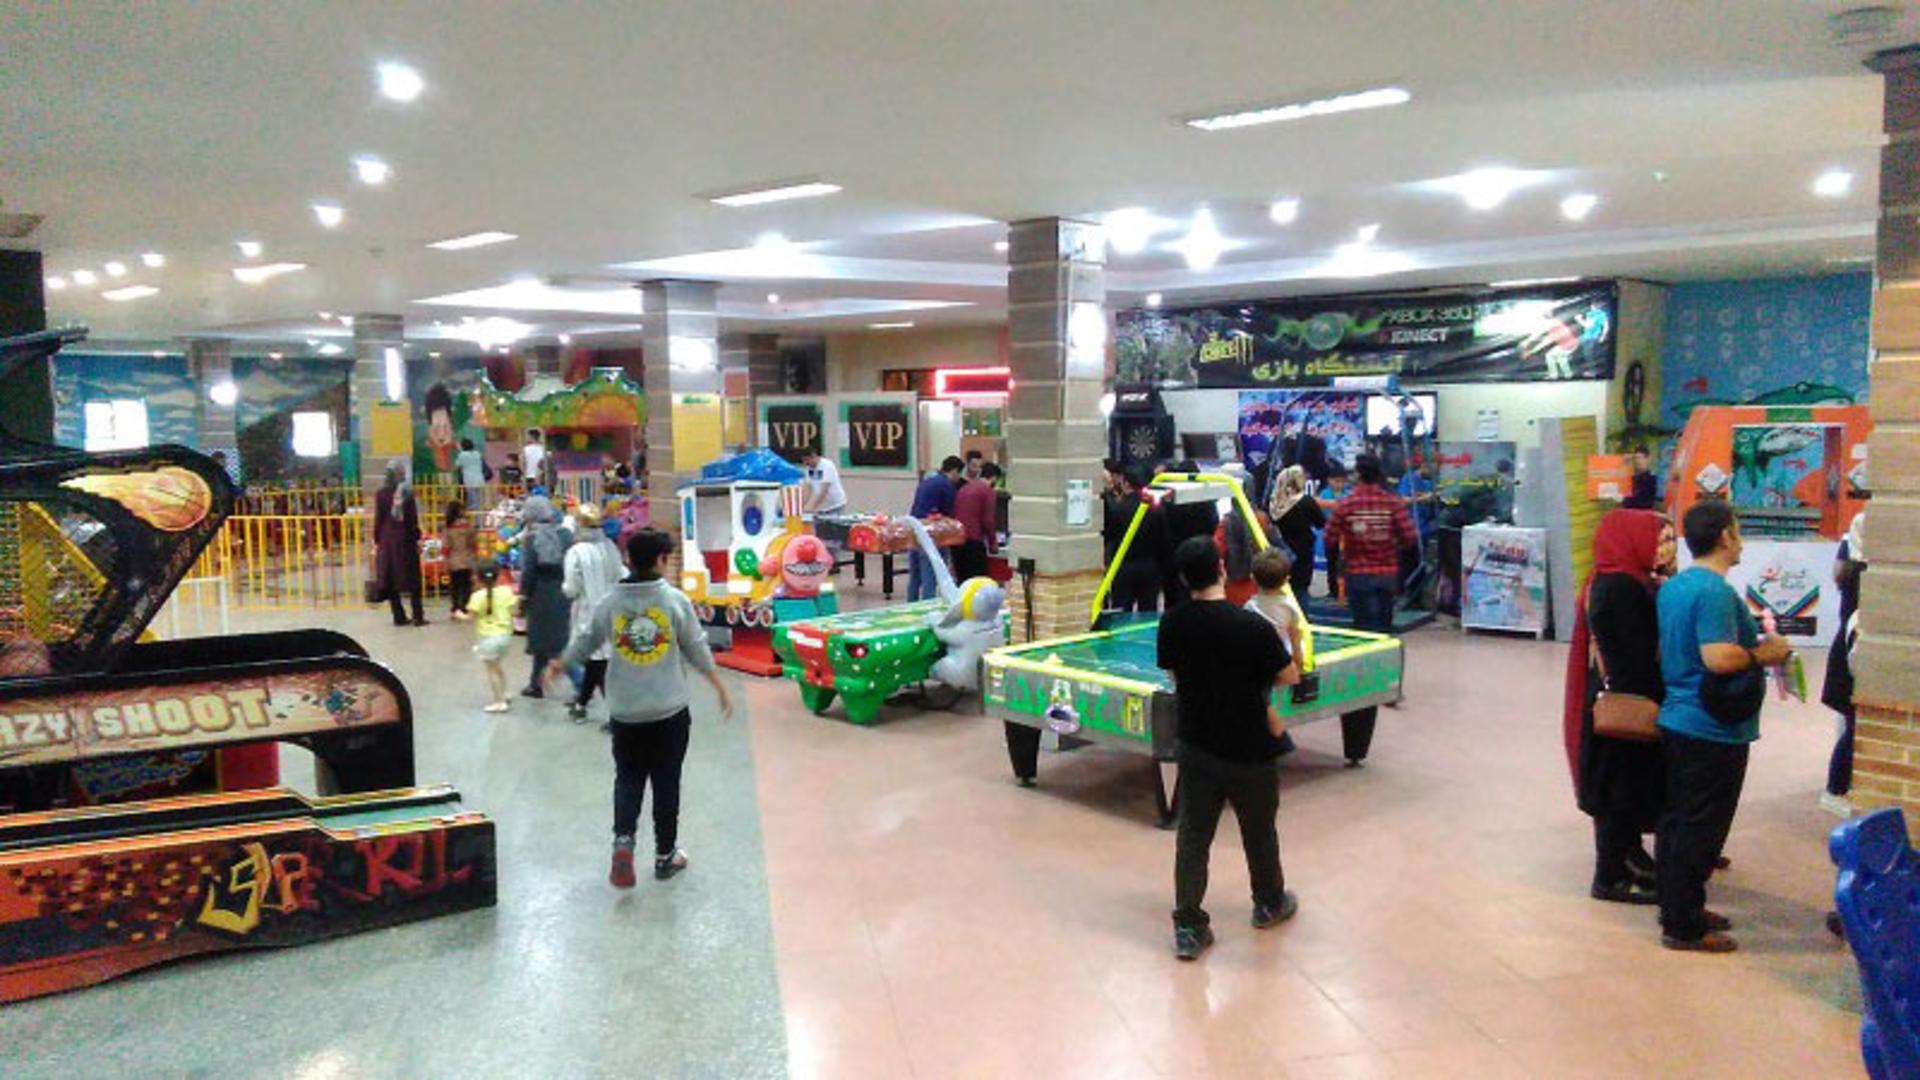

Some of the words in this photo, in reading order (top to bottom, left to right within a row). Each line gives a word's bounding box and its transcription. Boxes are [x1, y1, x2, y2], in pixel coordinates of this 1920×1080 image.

[1252, 359, 1299, 381] بازی
[772, 421, 817, 448] VIP
[853, 421, 903, 450] VIP
[95, 689, 268, 736] SHOOT
